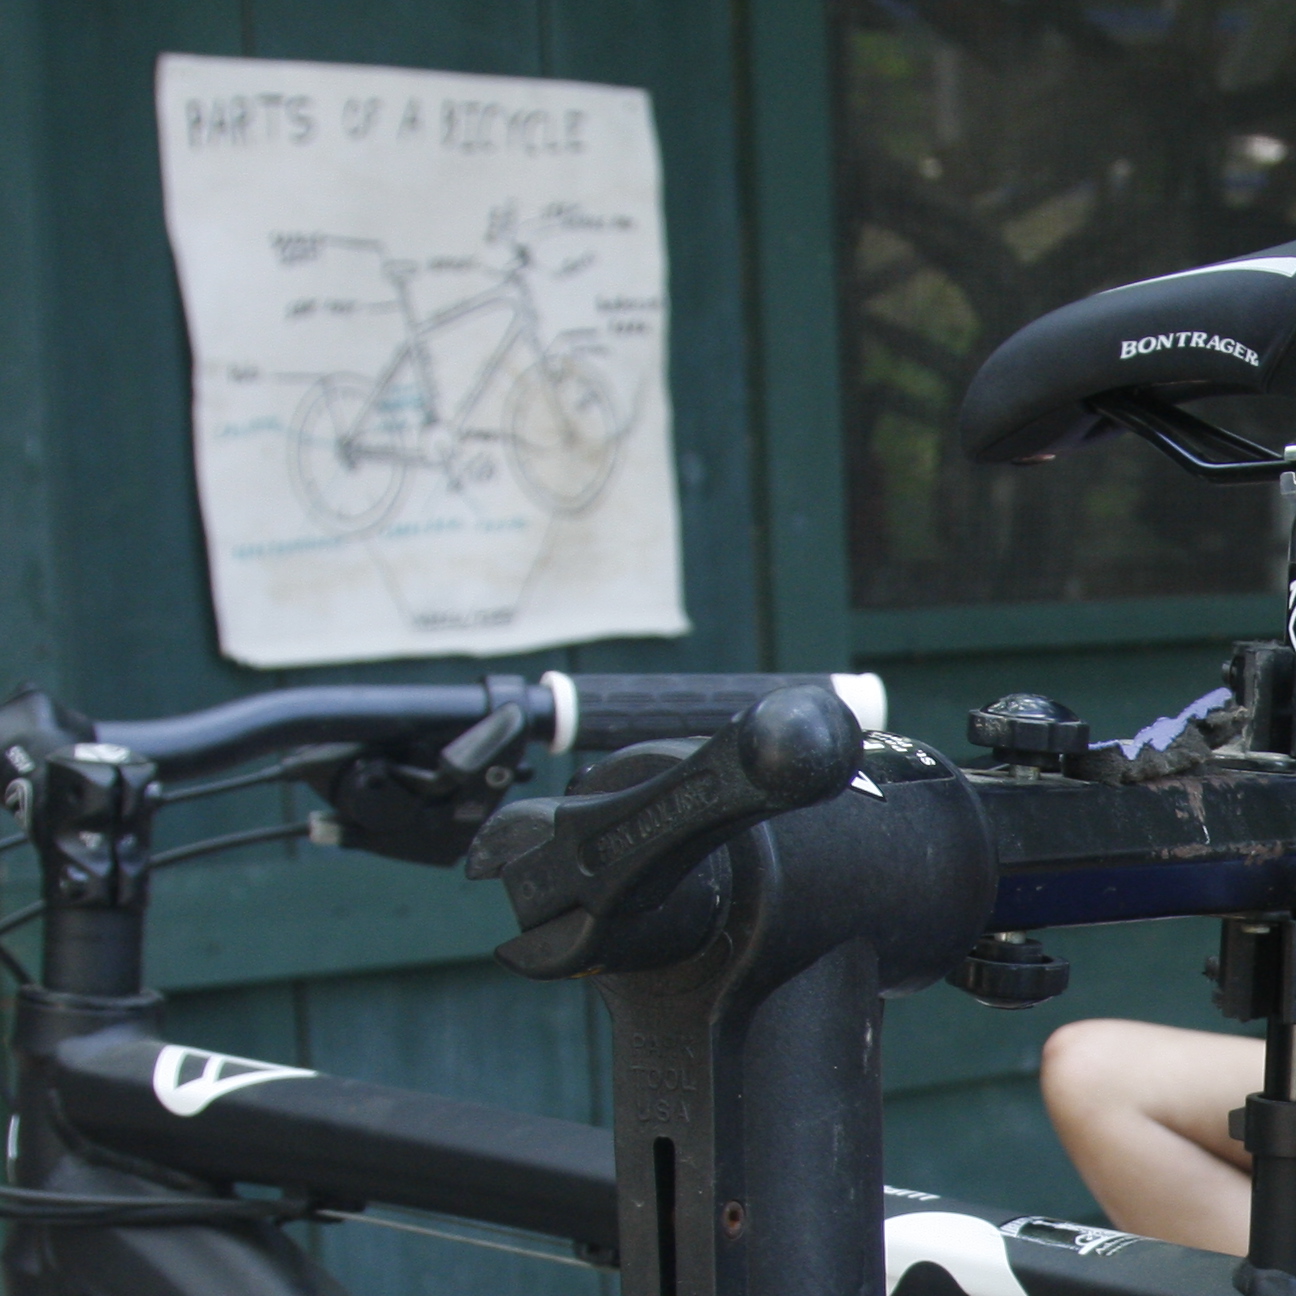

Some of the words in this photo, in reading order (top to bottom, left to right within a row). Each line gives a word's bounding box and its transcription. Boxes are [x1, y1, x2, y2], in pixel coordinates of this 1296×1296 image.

[185, 93, 315, 147] PARTS
[342, 96, 384, 141] OF
[397, 96, 422, 139] A
[440, 98, 590, 155] BICYCLE
[1119, 331, 1260, 367] BONTRAGER
[629, 1064, 697, 1091] TOOL
[636, 1097, 692, 1122] USA
